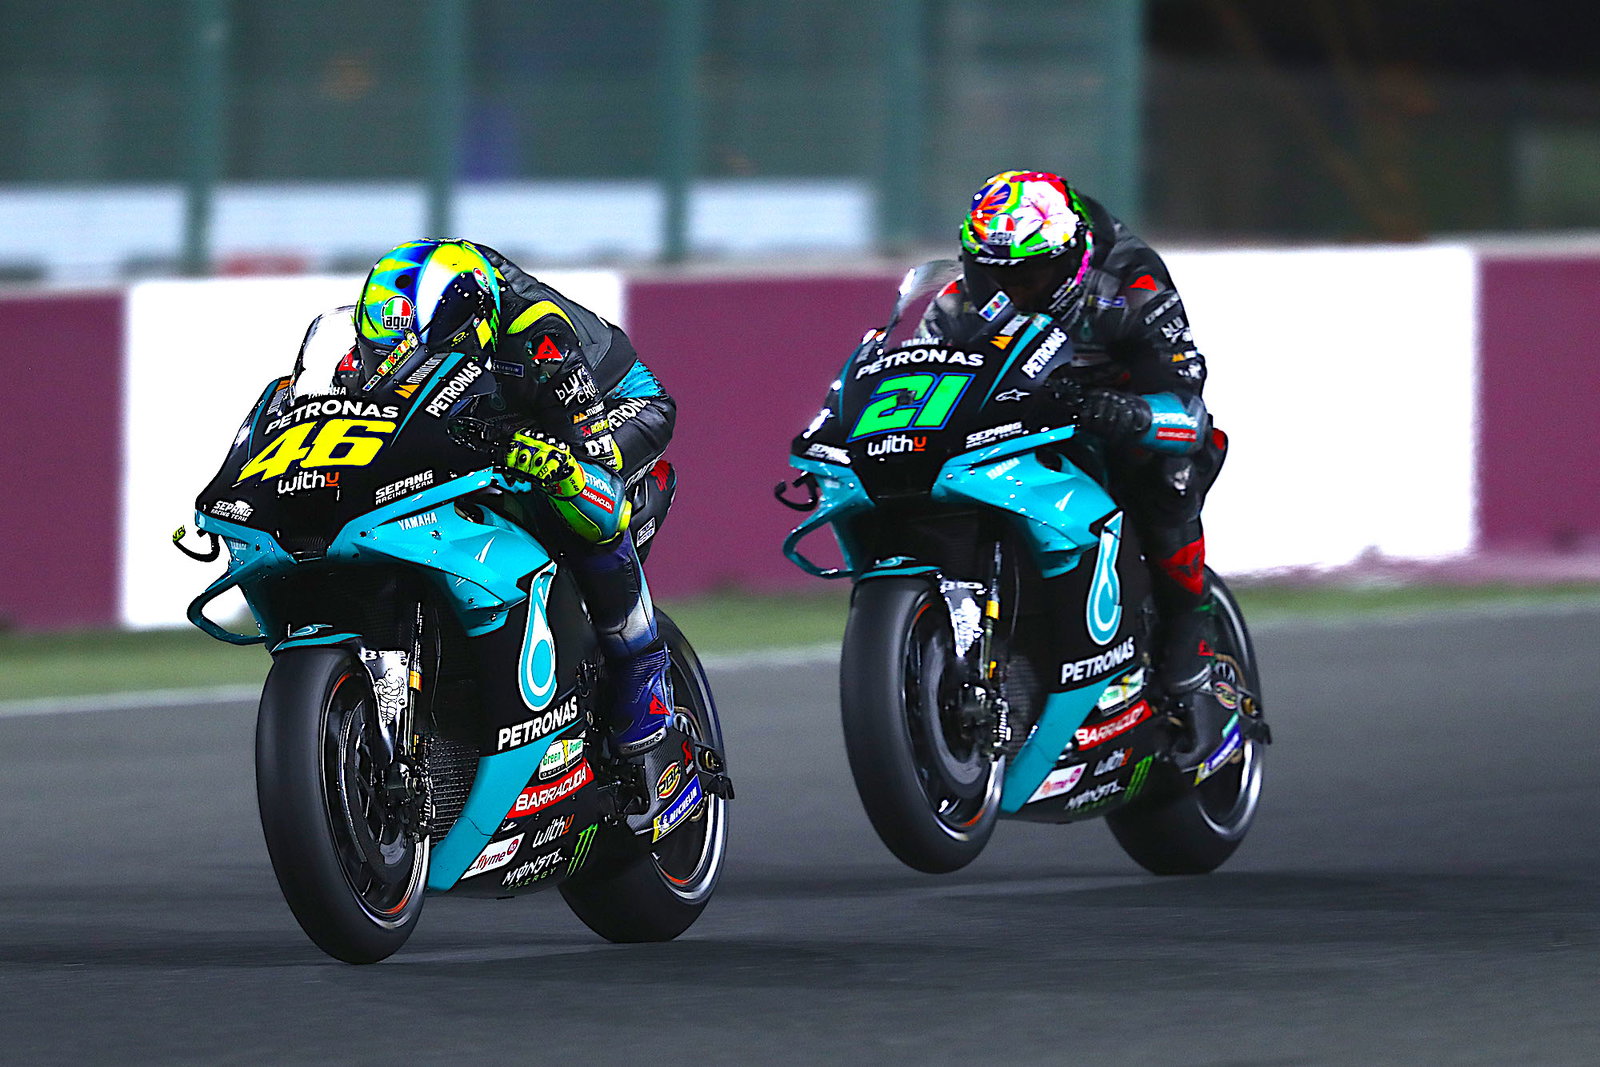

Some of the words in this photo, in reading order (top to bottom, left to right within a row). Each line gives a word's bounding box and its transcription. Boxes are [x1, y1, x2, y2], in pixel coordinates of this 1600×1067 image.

[855, 348, 985, 380] PETRONAS
[1021, 327, 1068, 378] PETRONAS
[424, 361, 482, 417] PETRONAS
[846, 372, 977, 443] 21
[264, 399, 400, 435] PETRONAS
[237, 418, 397, 482] 46
[375, 469, 433, 500] SEPANG
[375, 488, 407, 506] RACING
[410, 479, 434, 491] TEAM
[397, 511, 438, 531] YAMAHA
[1060, 636, 1135, 684] PETRONAS
[497, 695, 578, 751] PETRONAS
[515, 765, 587, 812] BARRACUDA
[668, 786, 699, 824] MICHELIN
[476, 851, 506, 871] flyme
[501, 847, 563, 886] MONSTE
